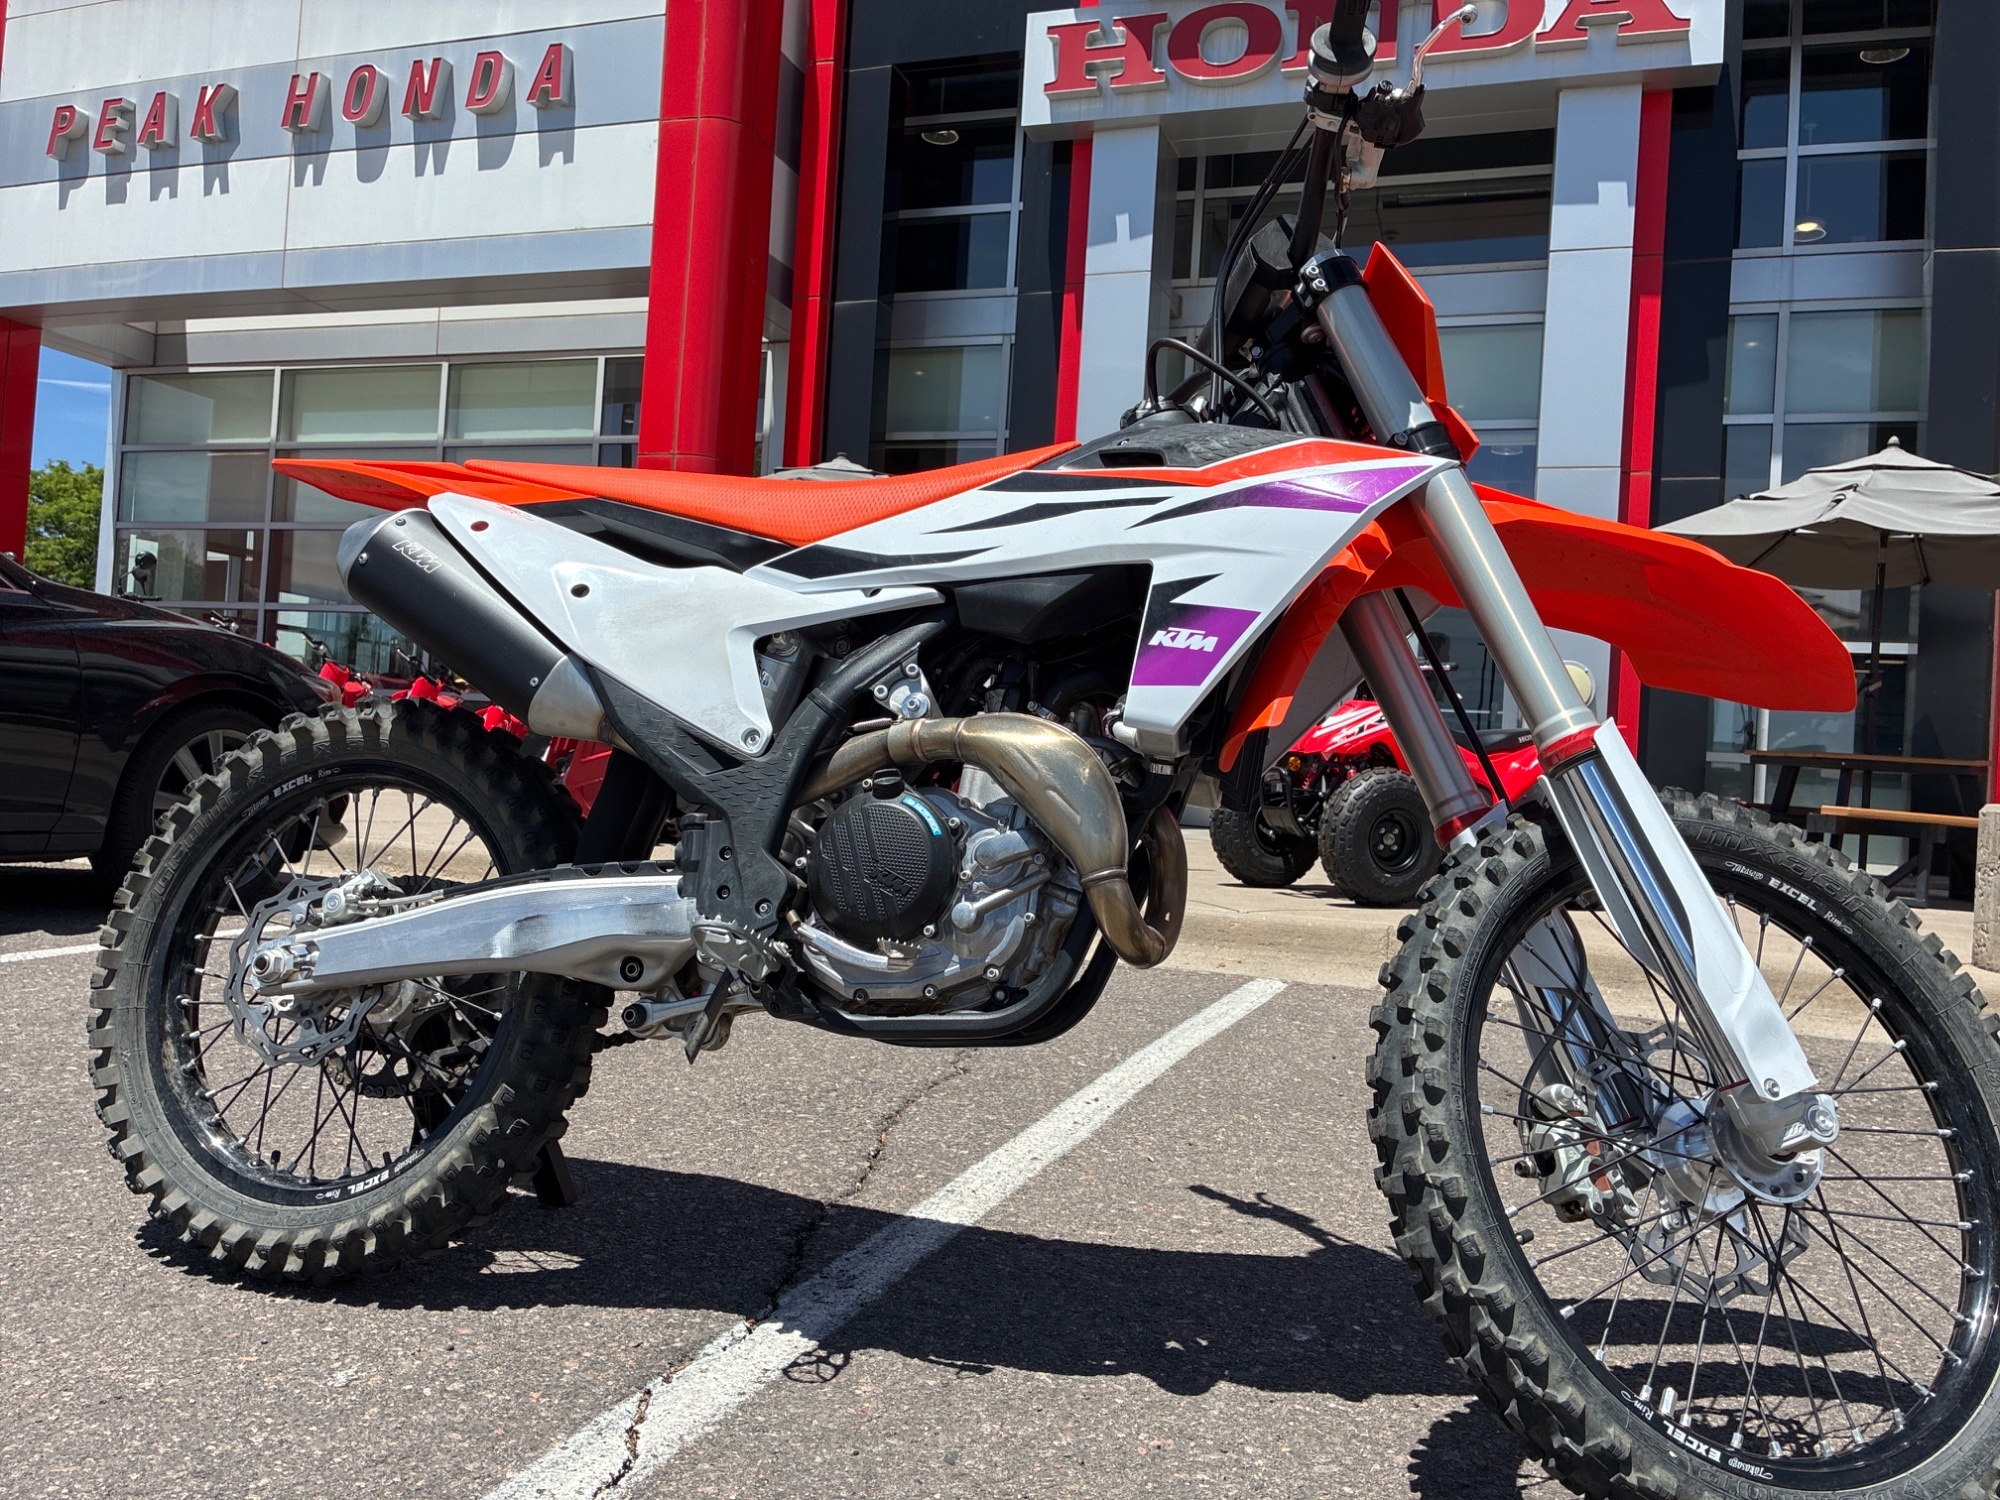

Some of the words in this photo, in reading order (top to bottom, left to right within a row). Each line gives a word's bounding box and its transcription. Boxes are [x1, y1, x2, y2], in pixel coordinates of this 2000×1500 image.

[46, 82, 236, 161] PEAK
[281, 42, 571, 135] HONDA
[392, 539, 442, 574] KTM
[1147, 626, 1219, 653] KTM
[273, 774, 312, 798] EXCEL
[1725, 860, 1764, 881] Takasago
[1768, 876, 1818, 912] EXCEL
[1823, 910, 1853, 935] Rim
[347, 1169, 390, 1195] EXCEL
[1620, 1390, 1655, 1421] Rim
[1663, 1419, 1722, 1464] EXCEL
[1728, 1457, 1774, 1480] Takasago
